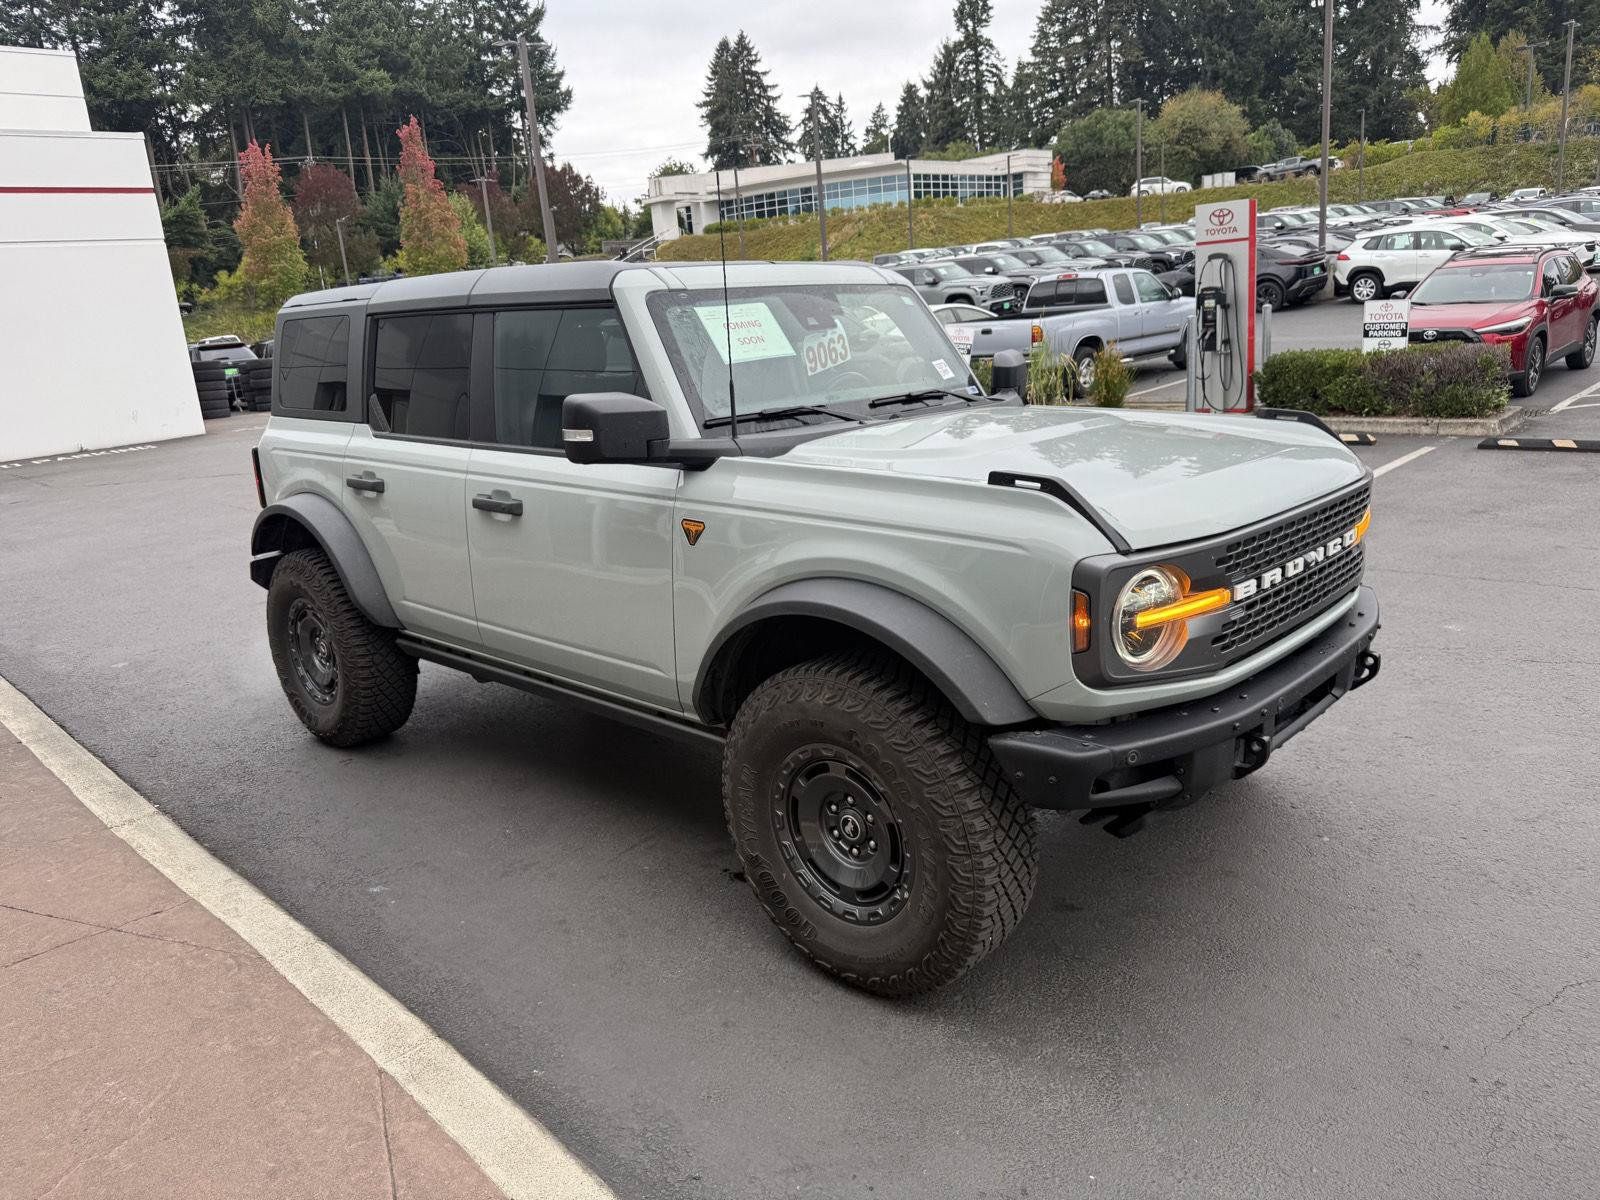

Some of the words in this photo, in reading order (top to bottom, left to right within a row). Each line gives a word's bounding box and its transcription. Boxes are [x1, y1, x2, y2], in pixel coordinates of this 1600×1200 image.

[1205, 226, 1238, 236] TOYOTA
[1369, 312, 1404, 320] TOYOTA
[722, 319, 763, 331] COMING
[1364, 322, 1407, 331] CUSTOMER
[736, 335, 766, 346] SOON
[805, 334, 849, 373] 9063
[1233, 528, 1358, 601] BRONCO
